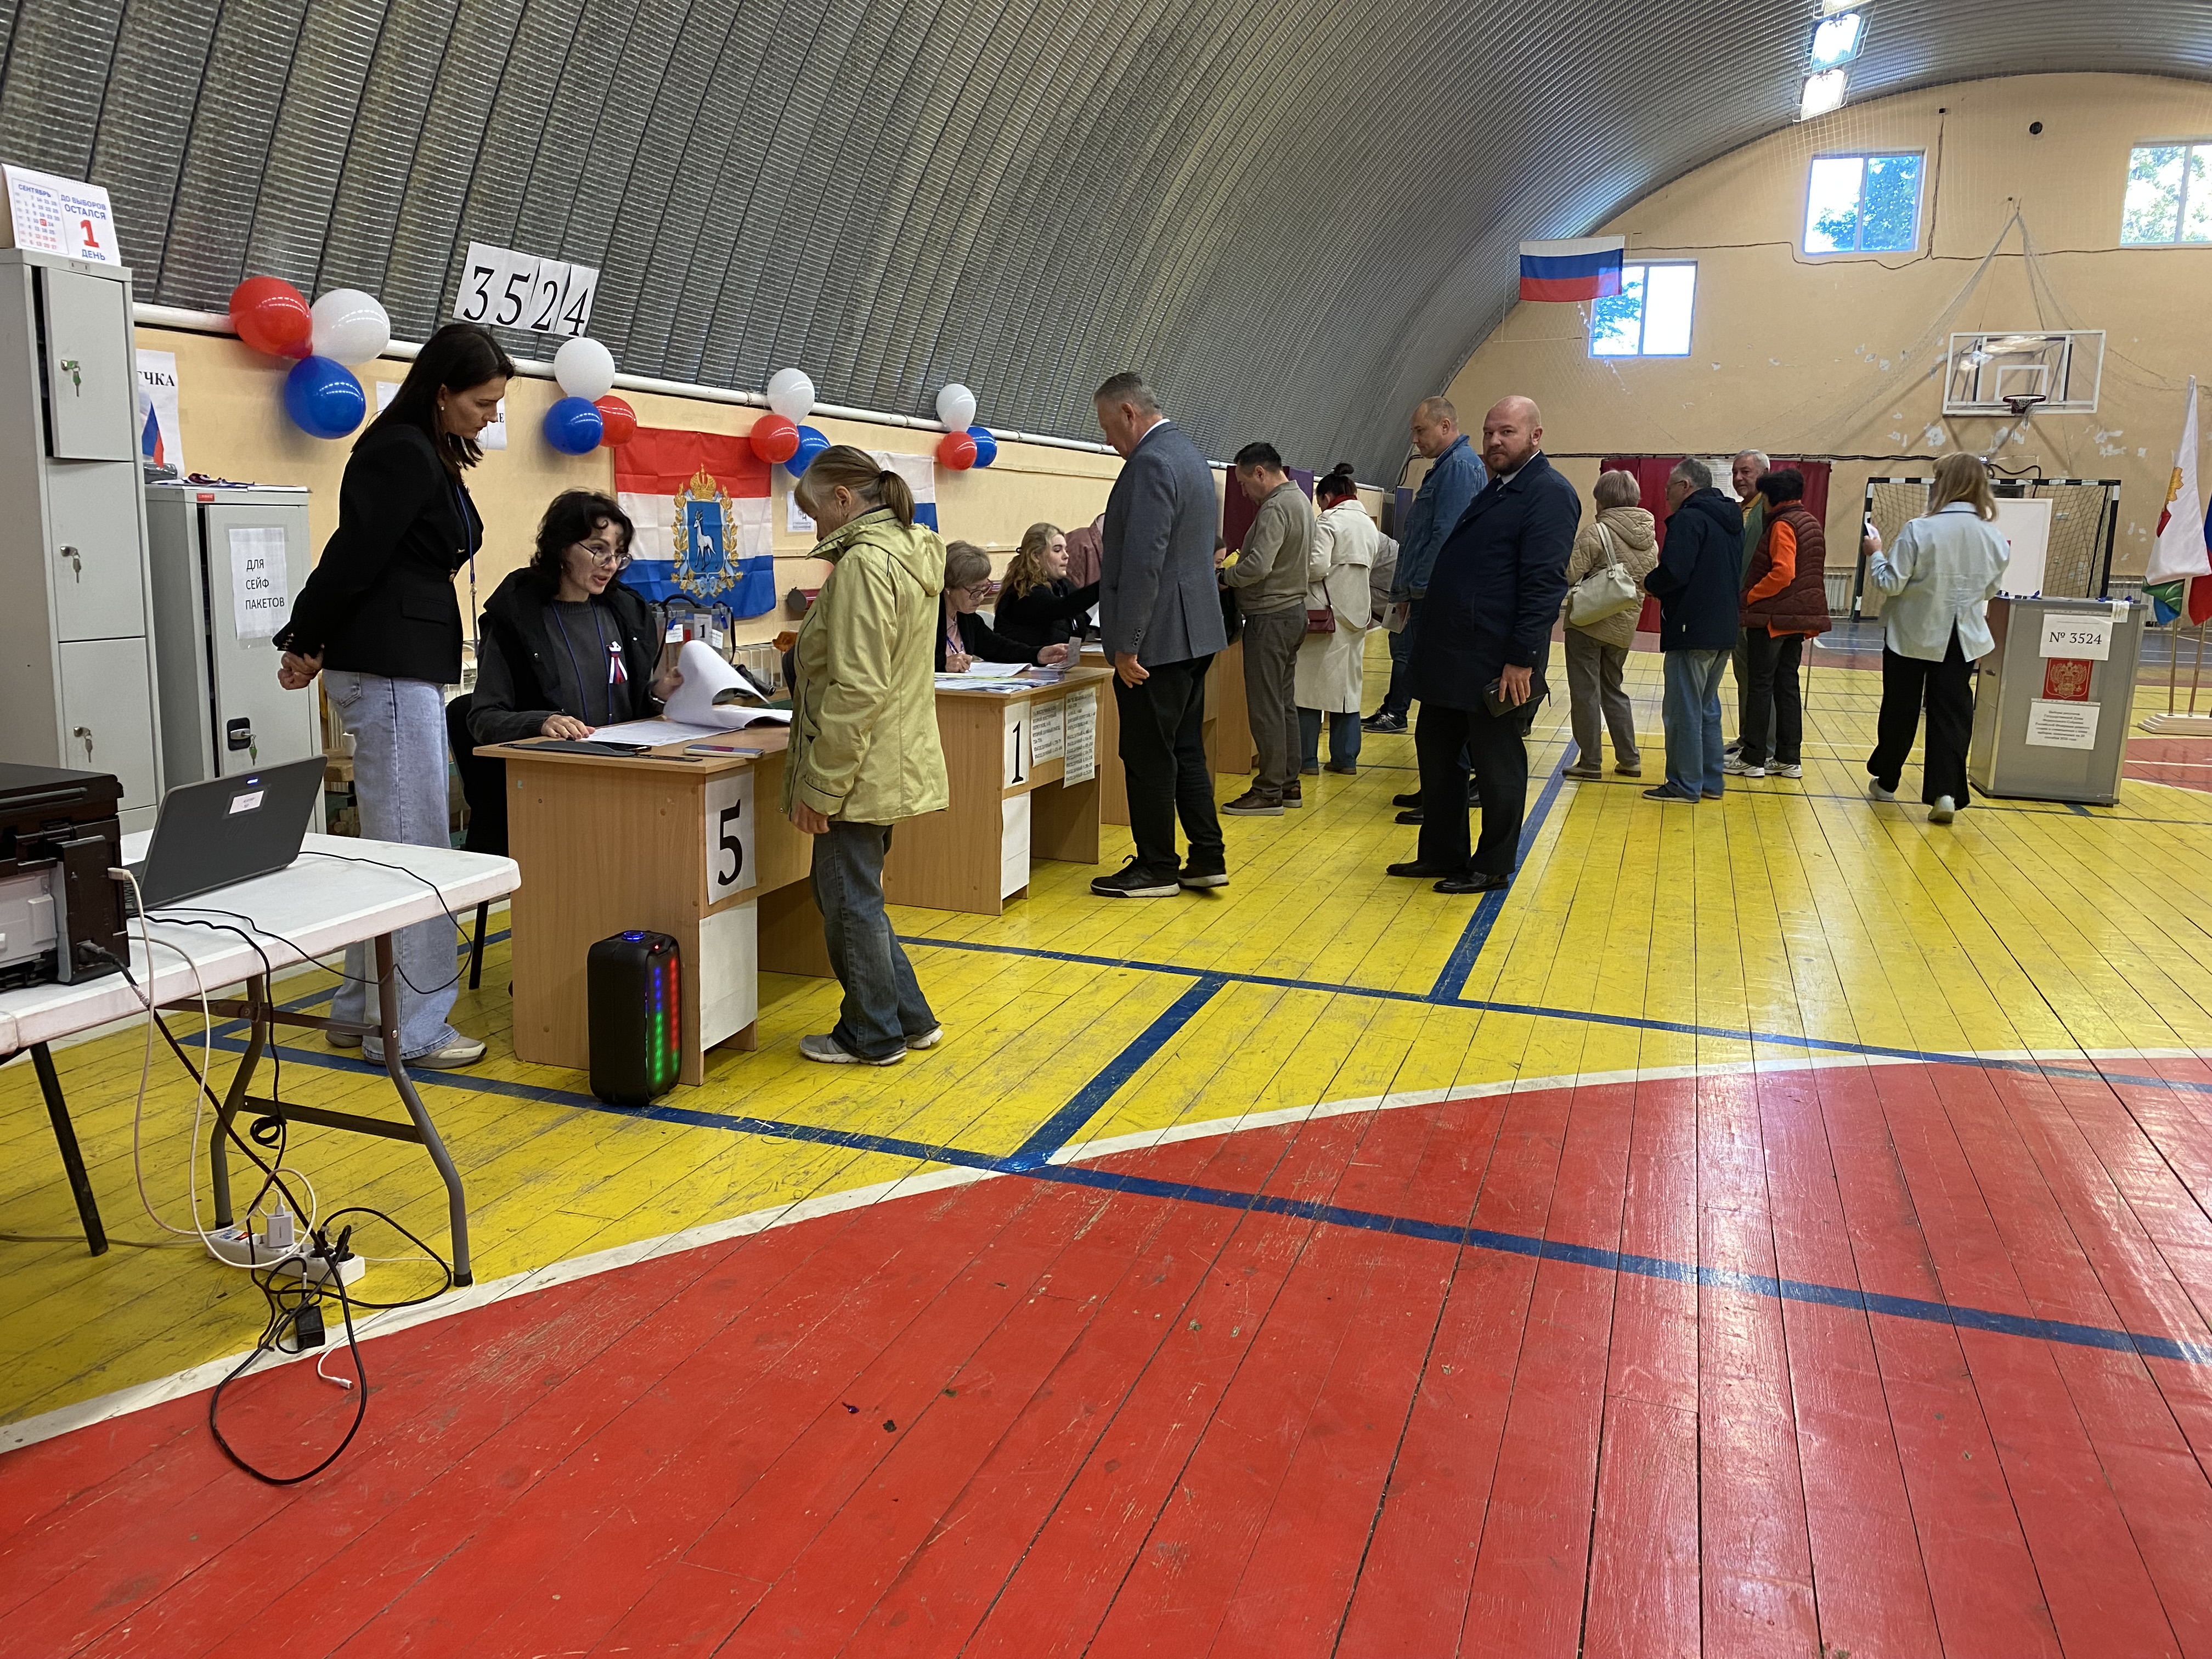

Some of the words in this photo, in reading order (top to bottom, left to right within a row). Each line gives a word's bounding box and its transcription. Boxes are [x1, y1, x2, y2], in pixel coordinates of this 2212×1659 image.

[18, 184, 51, 197] СЕНТЯБРЬ
[72, 198, 106, 210] ВЫБОРОВ
[65, 205, 106, 219] ОСТАЛСЯ
[80, 219, 99, 248] 1
[82, 250, 105, 260] ДЕНЬ
[463, 266, 588, 336] 3524
[246, 559, 264, 572] ДЛЯ
[246, 577, 269, 590] СЕЙФ
[245, 597, 285, 610] ПАКЕТОВ
[2069, 633, 2102, 645] 3524
[1012, 721, 1024, 784] 1
[718, 799, 743, 886] 5
